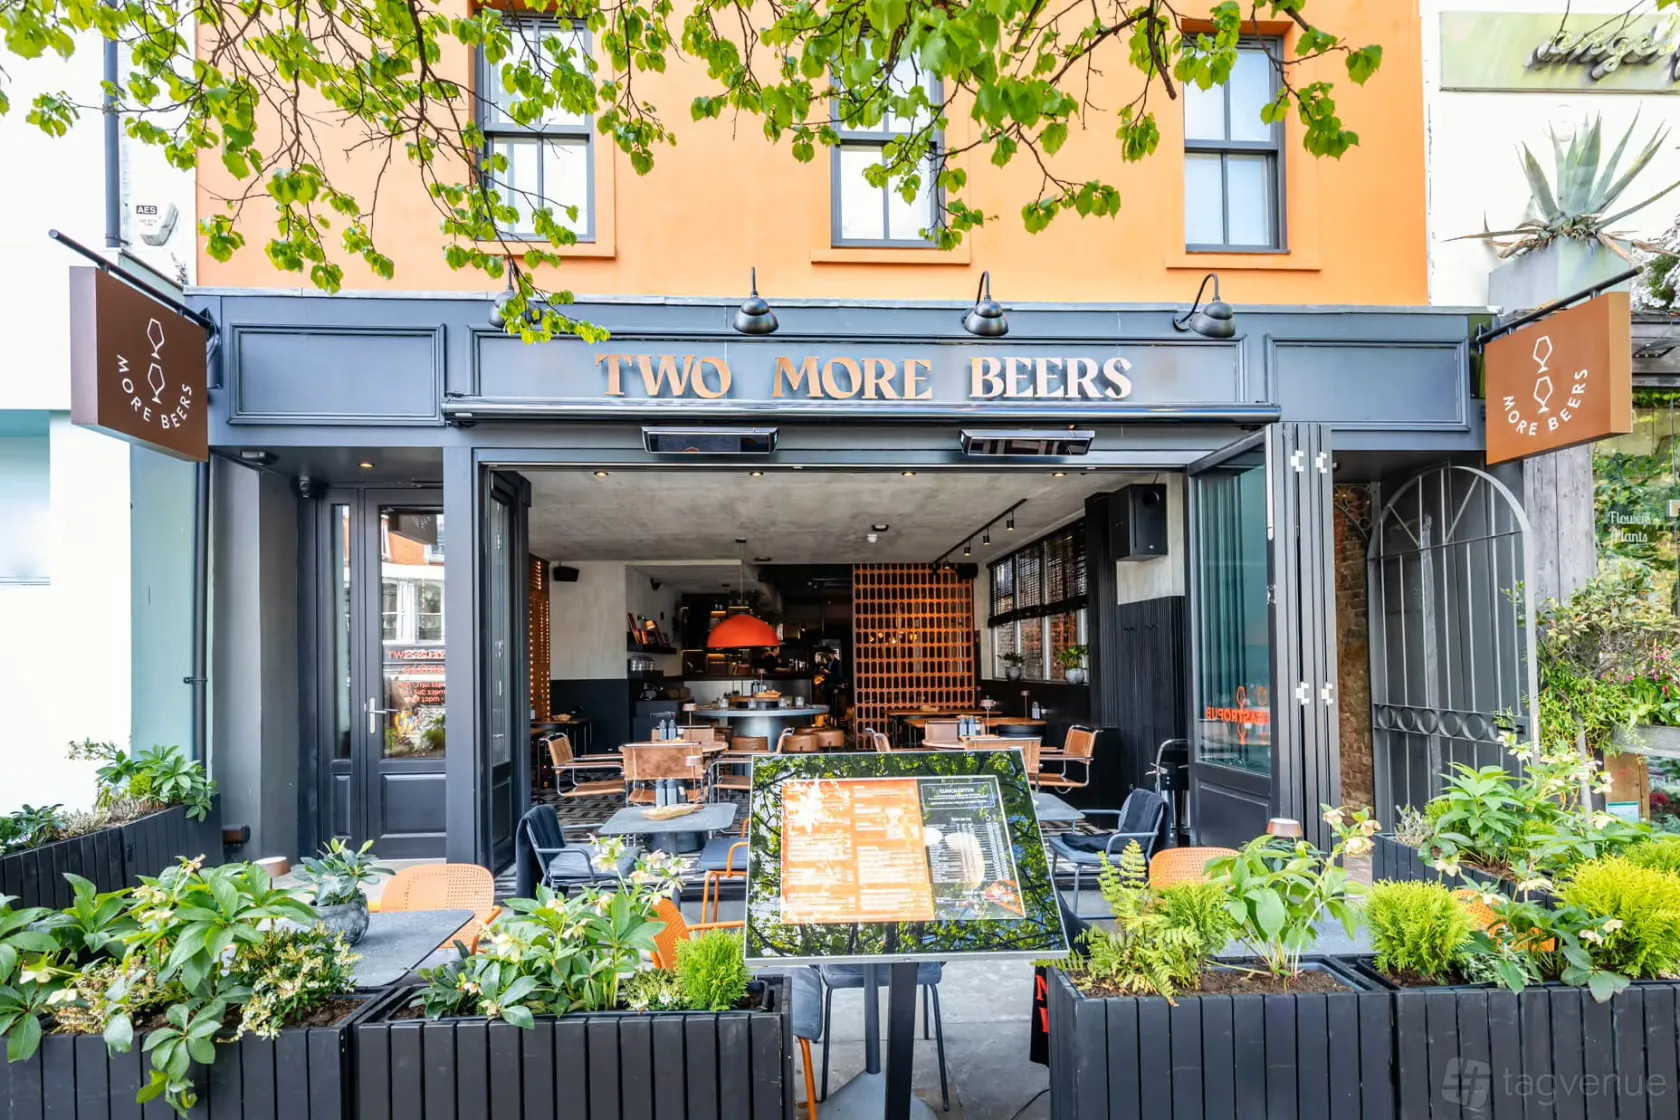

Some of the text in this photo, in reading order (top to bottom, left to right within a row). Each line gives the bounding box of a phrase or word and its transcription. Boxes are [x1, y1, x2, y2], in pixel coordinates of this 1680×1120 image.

[137, 206, 156, 214] AES
[117, 354, 192, 429] MORE BEERS
[595, 354, 1132, 400] TWO MORE BEERS
[1503, 369, 1588, 436] MORE BEERS
